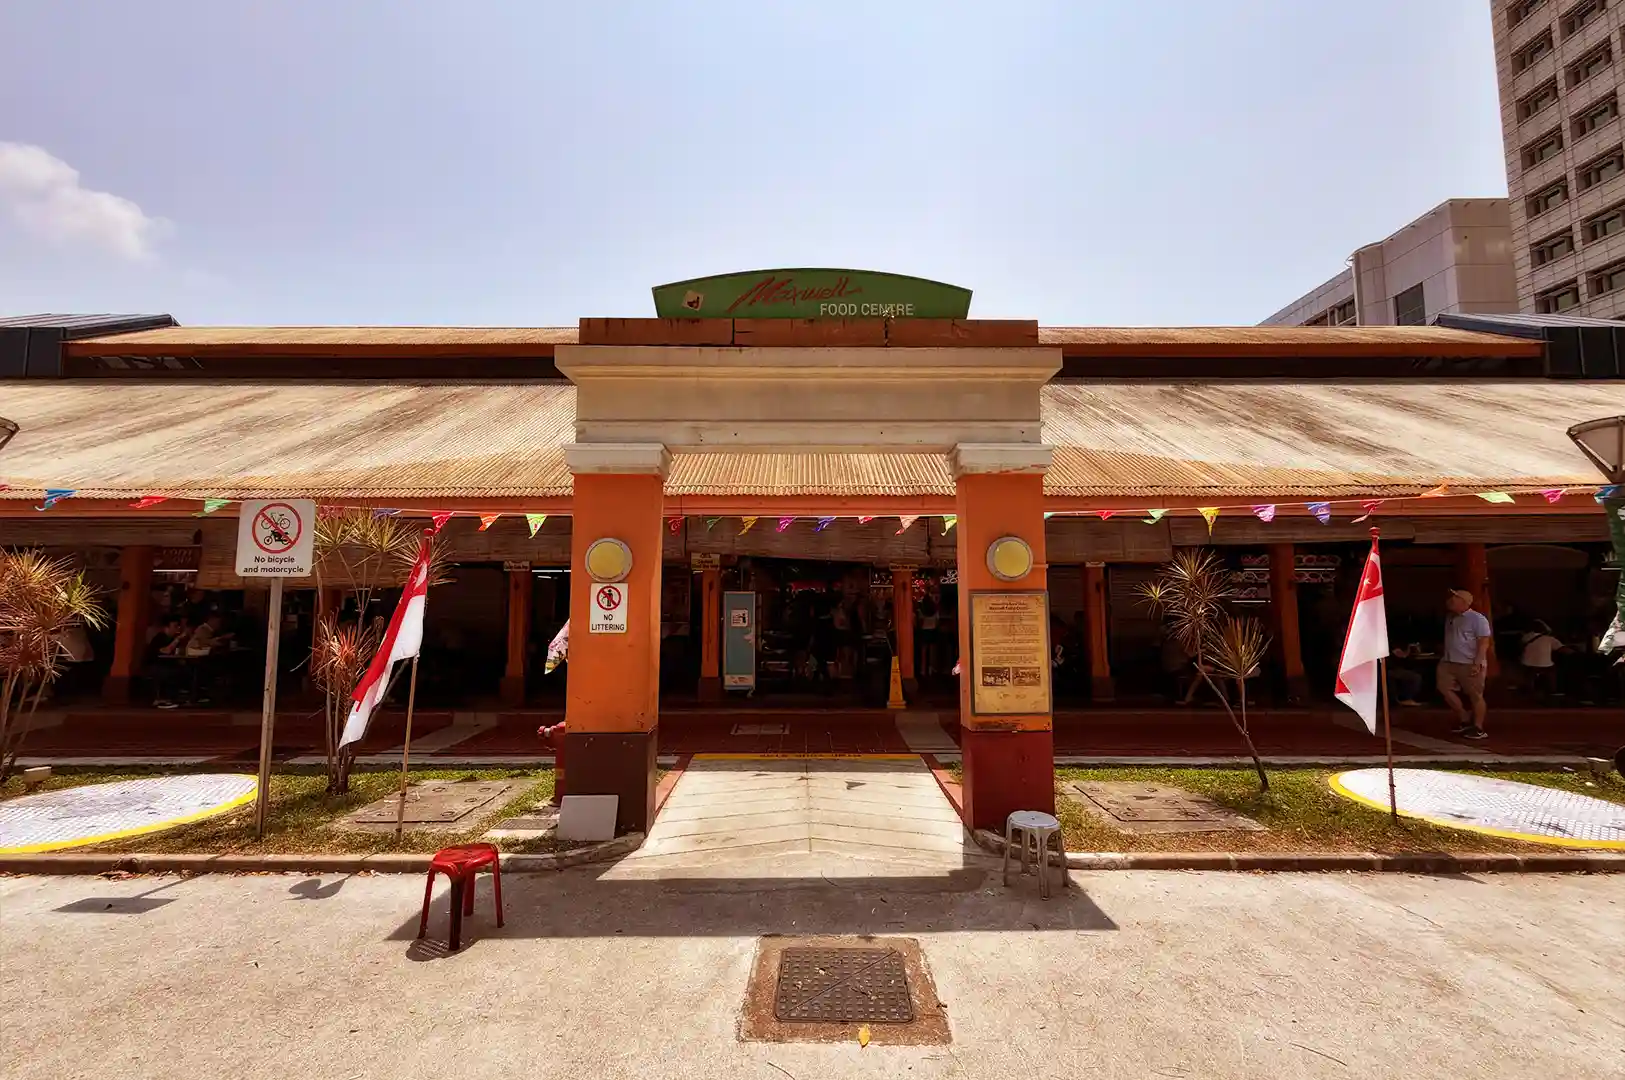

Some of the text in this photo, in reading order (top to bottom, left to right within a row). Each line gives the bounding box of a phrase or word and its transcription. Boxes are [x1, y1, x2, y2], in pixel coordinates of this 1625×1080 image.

[728, 276, 863, 313] Maxwell
[819, 303, 914, 316] FOOD CENTRE
[254, 555, 295, 565] No bicycle
[260, 566, 304, 574] motorcycle
[591, 623, 625, 631] LITTERING
